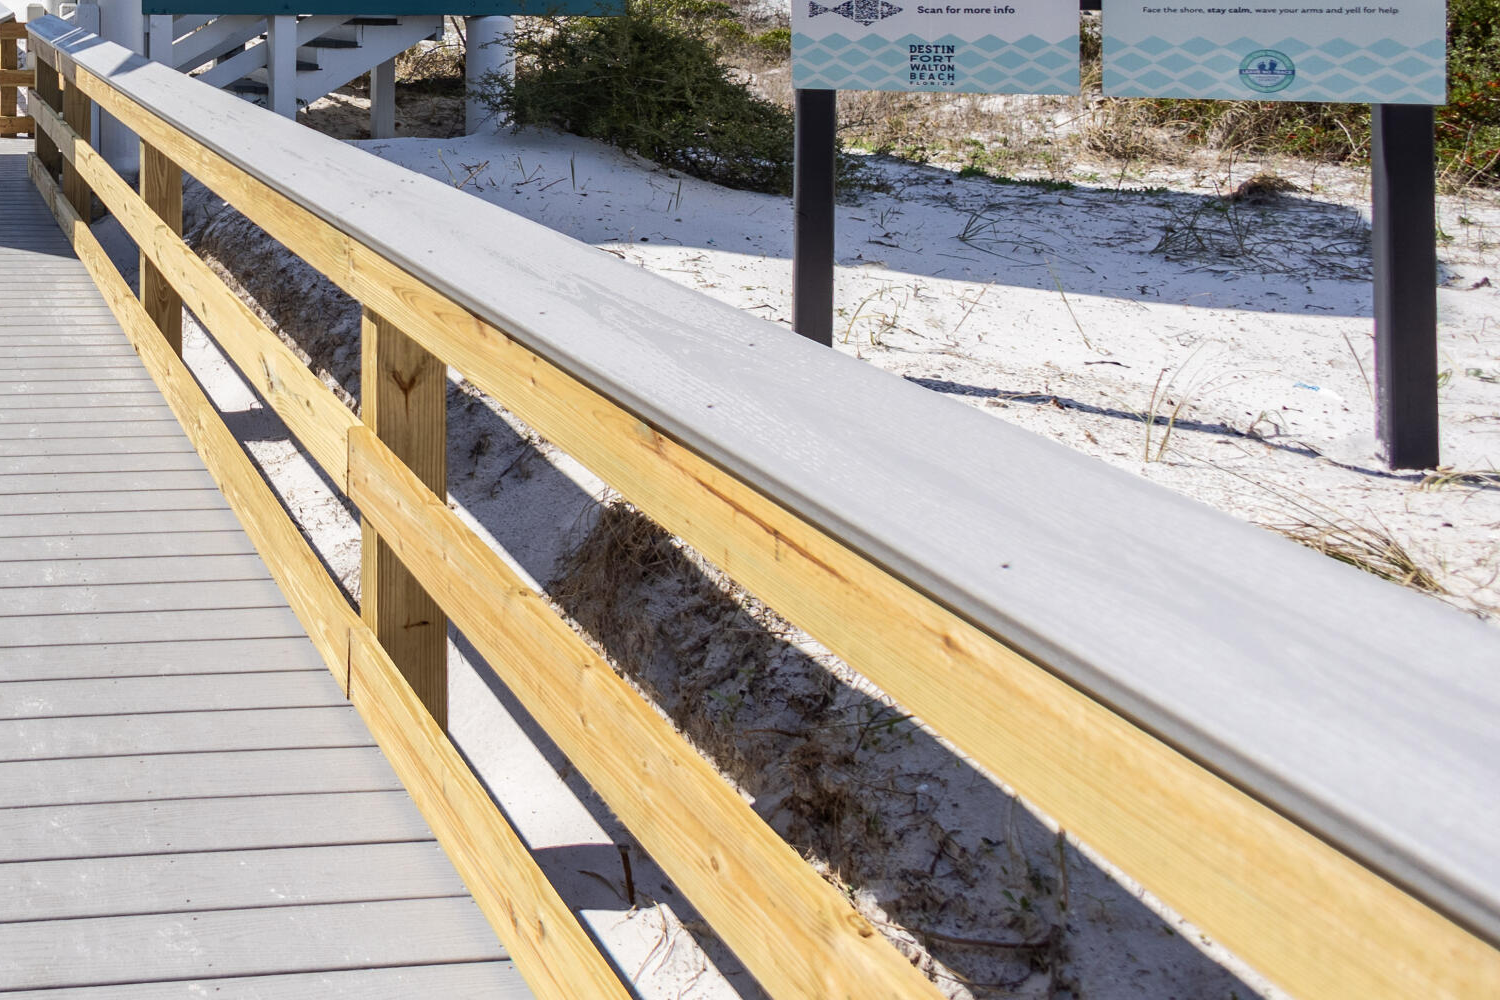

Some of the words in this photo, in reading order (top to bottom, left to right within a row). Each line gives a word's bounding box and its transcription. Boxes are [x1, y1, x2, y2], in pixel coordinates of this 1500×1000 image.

[917, 6, 943, 14] Scan
[946, 6, 961, 14] for
[994, 6, 1015, 14] info
[1208, 7, 1226, 15] stay
[1345, 7, 1361, 15] yell
[1379, 7, 1399, 15] help
[909, 45, 955, 54] DESTIN
